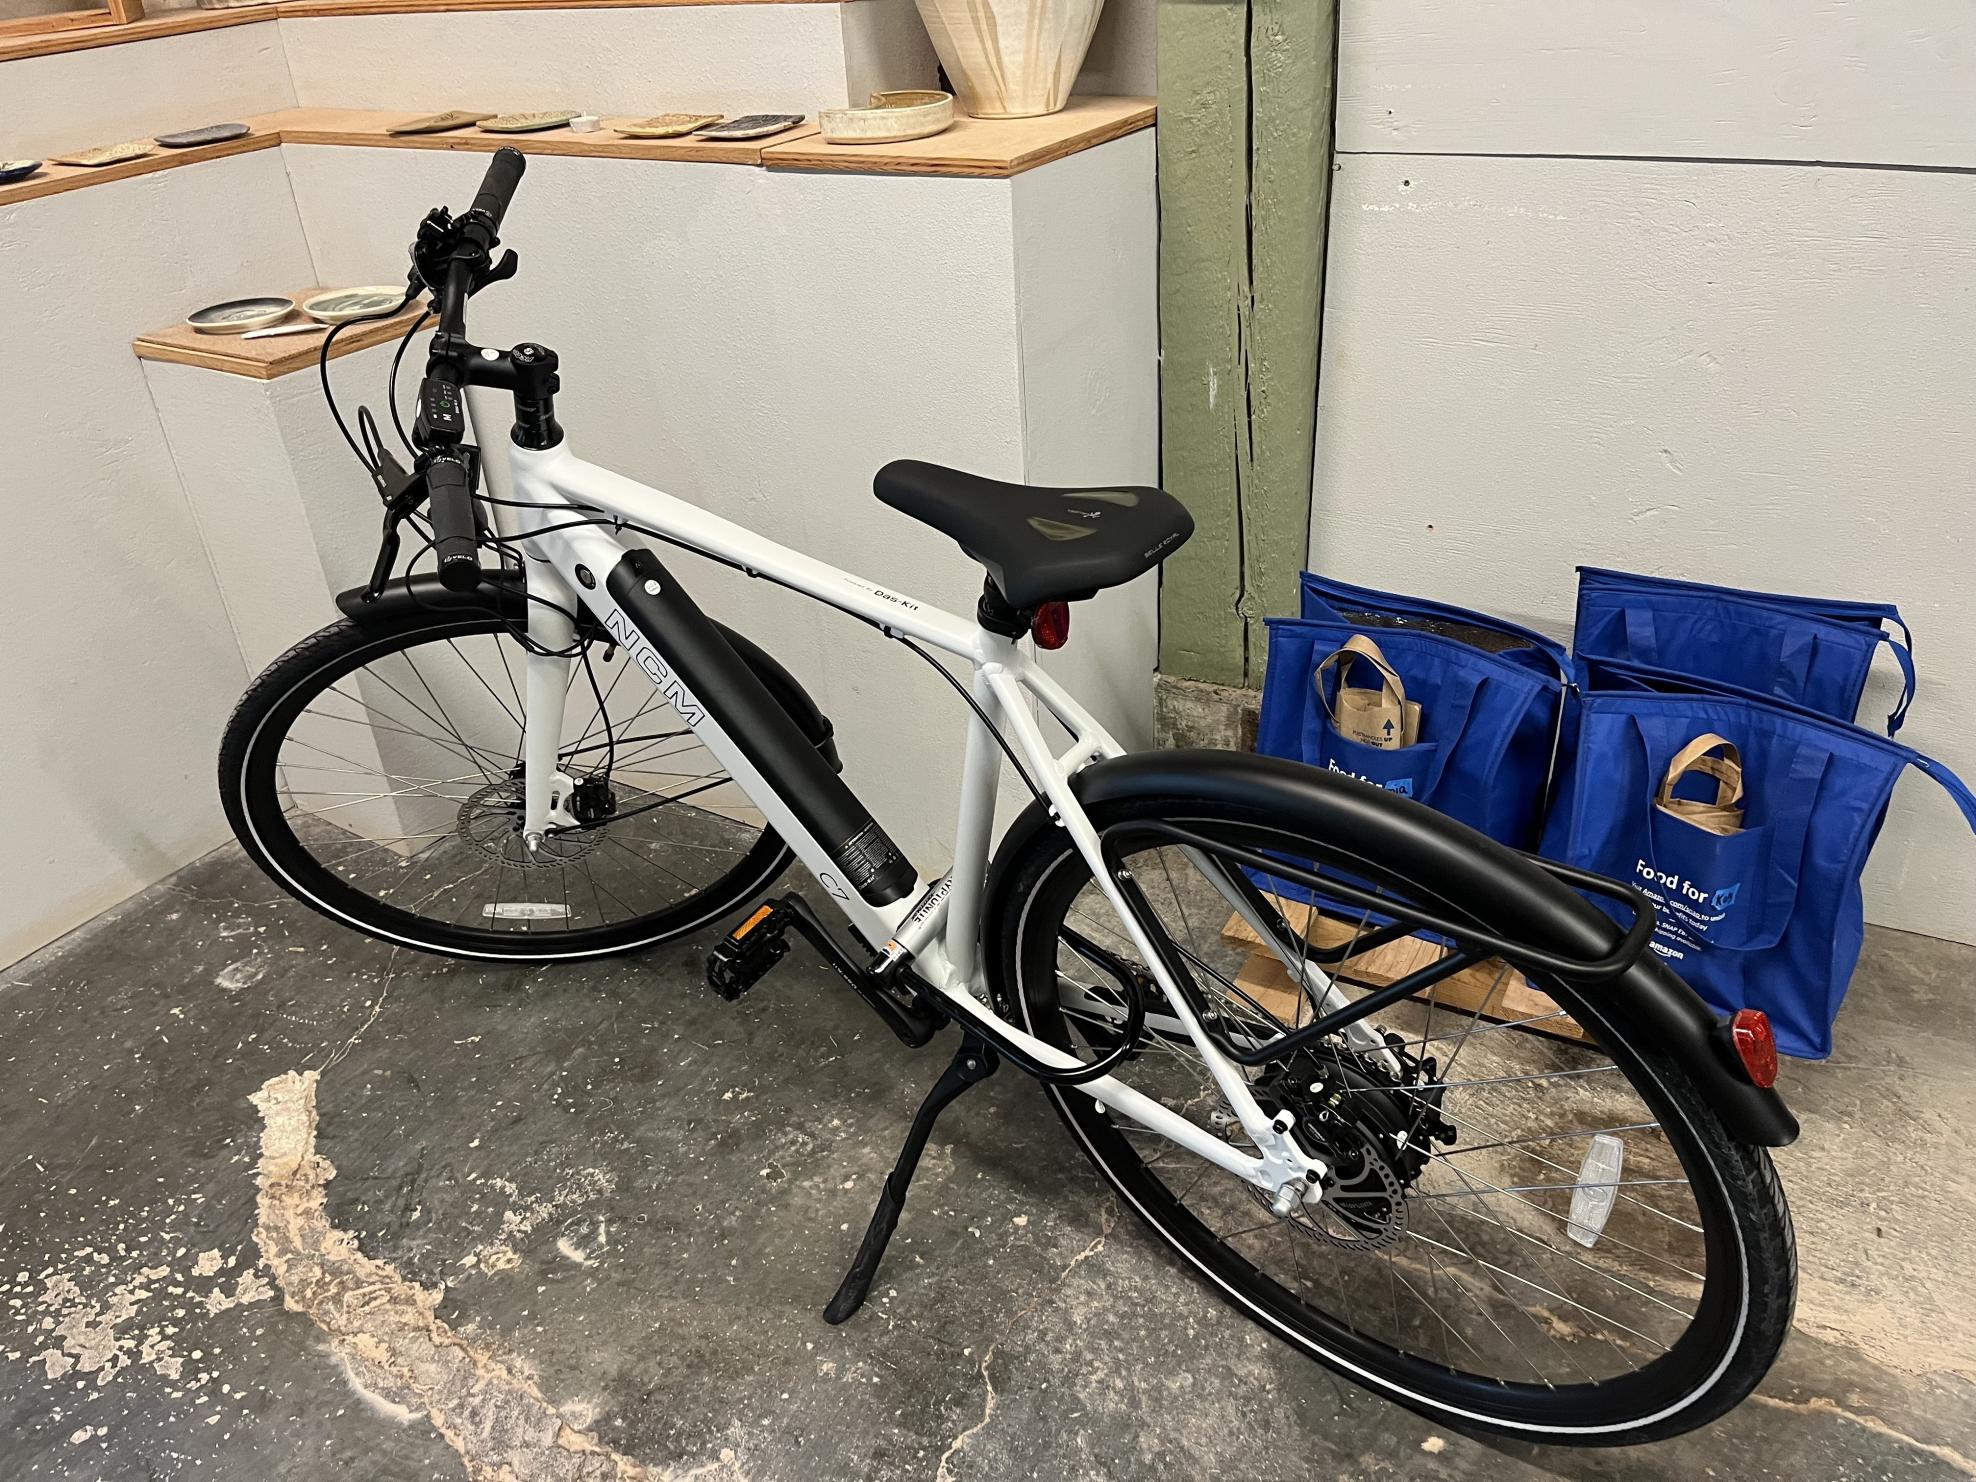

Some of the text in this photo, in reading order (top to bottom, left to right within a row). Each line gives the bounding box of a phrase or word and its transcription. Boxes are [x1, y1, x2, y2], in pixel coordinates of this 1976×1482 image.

[874, 590, 918, 611] Das-Kit
[604, 608, 705, 727] NCM
[820, 872, 850, 901] C7
[1636, 859, 1678, 890] Food
[1682, 881, 1709, 903] for
[914, 876, 953, 923] RYPTONITE
[1648, 941, 1684, 959] amazon
